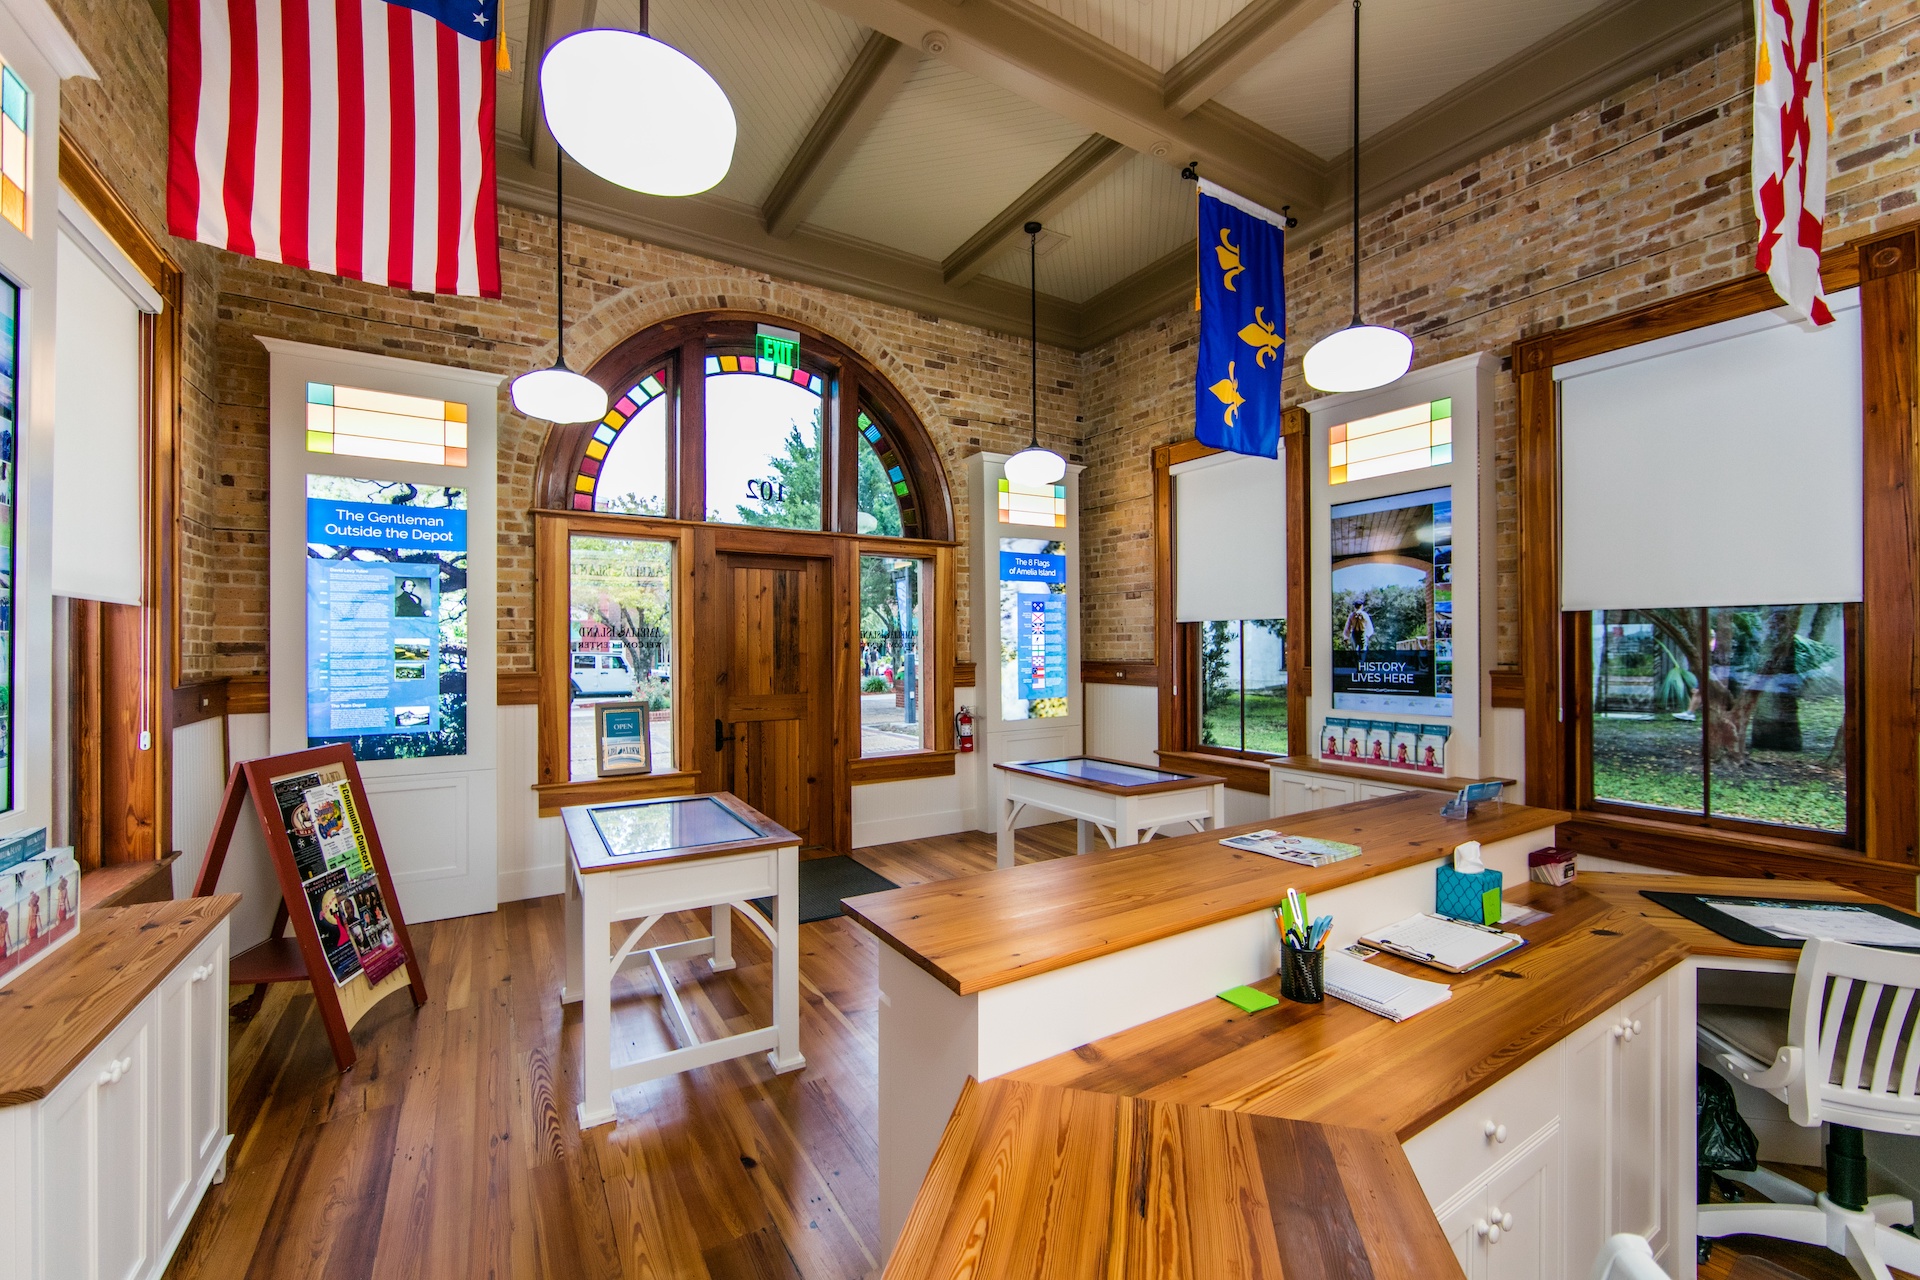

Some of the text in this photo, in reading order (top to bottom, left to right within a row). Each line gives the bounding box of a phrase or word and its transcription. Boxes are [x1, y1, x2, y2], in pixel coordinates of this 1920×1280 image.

[763, 338, 793, 367] EXIT
[335, 508, 444, 528] The Gentleman
[324, 523, 454, 544] Outside the Depot
[1015, 557, 1051, 569] The 8 Flags
[1009, 566, 1057, 578] of Amelia Island
[1358, 661, 1406, 673] HISTORY
[1351, 672, 1414, 684] LIVES HERE
[342, 788, 361, 835] Community
[356, 835, 372, 867] Concert
